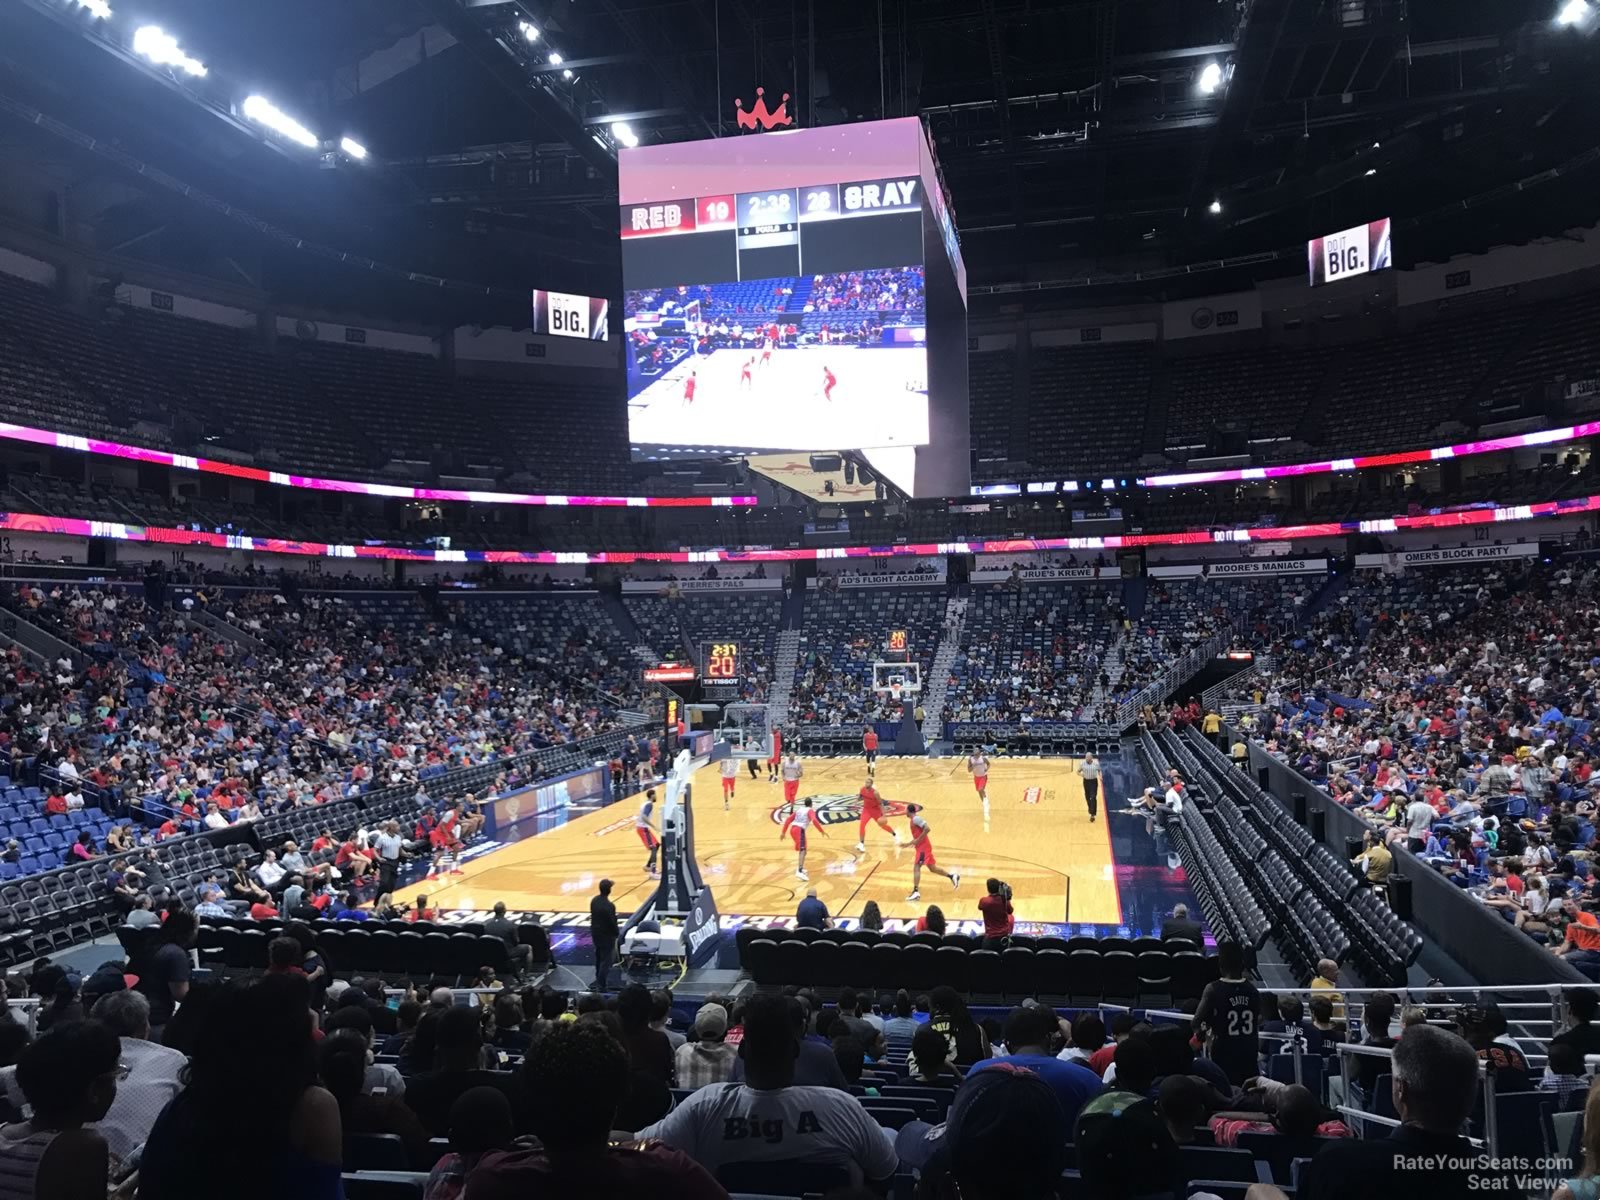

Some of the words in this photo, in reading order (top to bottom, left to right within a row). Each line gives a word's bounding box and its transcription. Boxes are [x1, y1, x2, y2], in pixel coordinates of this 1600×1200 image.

[845, 180, 916, 210] GRAY
[632, 204, 682, 231] RED
[1328, 239, 1338, 253] DO
[1339, 236, 1347, 250] IT
[1329, 246, 1365, 276] BIG.
[553, 308, 585, 333] BIG.
[1214, 531, 1224, 541] DO
[1226, 531, 1233, 540] IT
[1474, 527, 1490, 541] 121
[172, 551, 184, 565] 114
[1405, 550, 1440, 562] OMER'S
[1442, 548, 1475, 559] BLOCK
[1477, 546, 1510, 557] PARTY
[308, 560, 322, 574] 115
[874, 559, 888, 570] 118
[1215, 563, 1259, 573] MOORE'S
[1262, 561, 1305, 571] MANIACS
[841, 576, 861, 584] AD'S
[863, 575, 893, 584] FLIGHT
[896, 574, 939, 583] ACADEMY
[1022, 569, 1055, 578] JRUE'S
[1058, 568, 1092, 577] KREWE
[681, 580, 721, 589] PIERRE'S
[723, 580, 744, 588] PALS
[712, 644, 737, 656] 2:37
[709, 656, 734, 678] 20
[713, 678, 739, 686] TISSOT
[666, 860, 678, 899] NBA
[1229, 995, 1250, 1007] DAVIS
[1227, 1010, 1254, 1036] 23
[1285, 1025, 1304, 1036] DAVIS
[723, 1114, 784, 1144] Big
[796, 1111, 824, 1134] A
